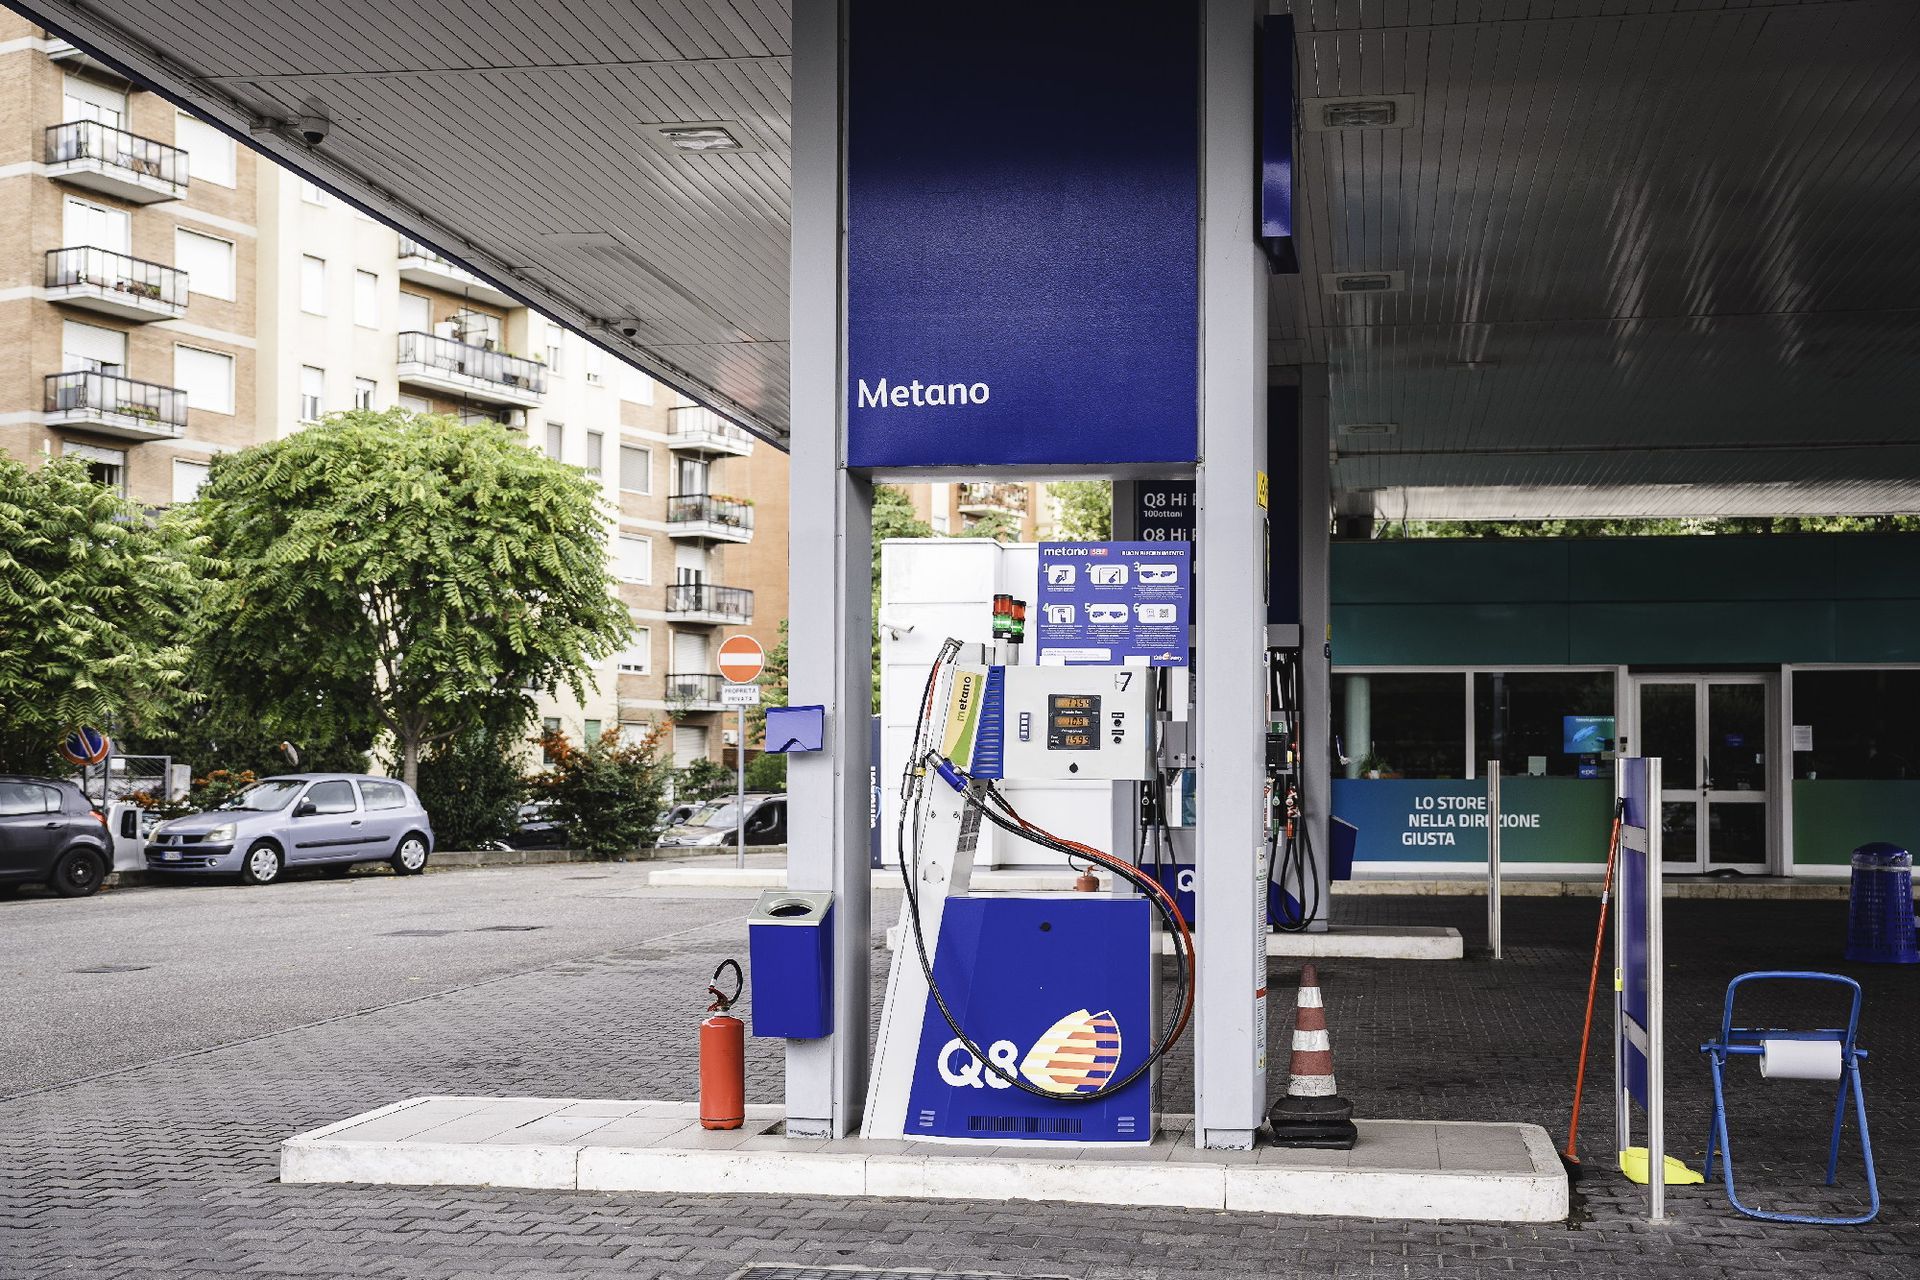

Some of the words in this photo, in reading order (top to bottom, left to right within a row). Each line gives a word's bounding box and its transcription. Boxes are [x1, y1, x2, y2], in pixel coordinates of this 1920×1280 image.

[857, 377, 990, 408] Metano
[1143, 493, 1166, 509] Q8
[1171, 493, 1187, 506] Hi
[1143, 510, 1183, 518] 100ottani
[1170, 528, 1187, 541] Hi
[1043, 547, 1088, 556] metano
[1120, 672, 1133, 692] 7
[956, 676, 972, 722] metano
[1415, 796, 1434, 810] LO
[1437, 796, 1486, 810] STORE
[1408, 813, 1456, 828] NELLA
[1459, 813, 1540, 828] DIRZIONE
[1402, 832, 1456, 846] GIUSTA
[937, 1037, 1019, 1090] Q8
